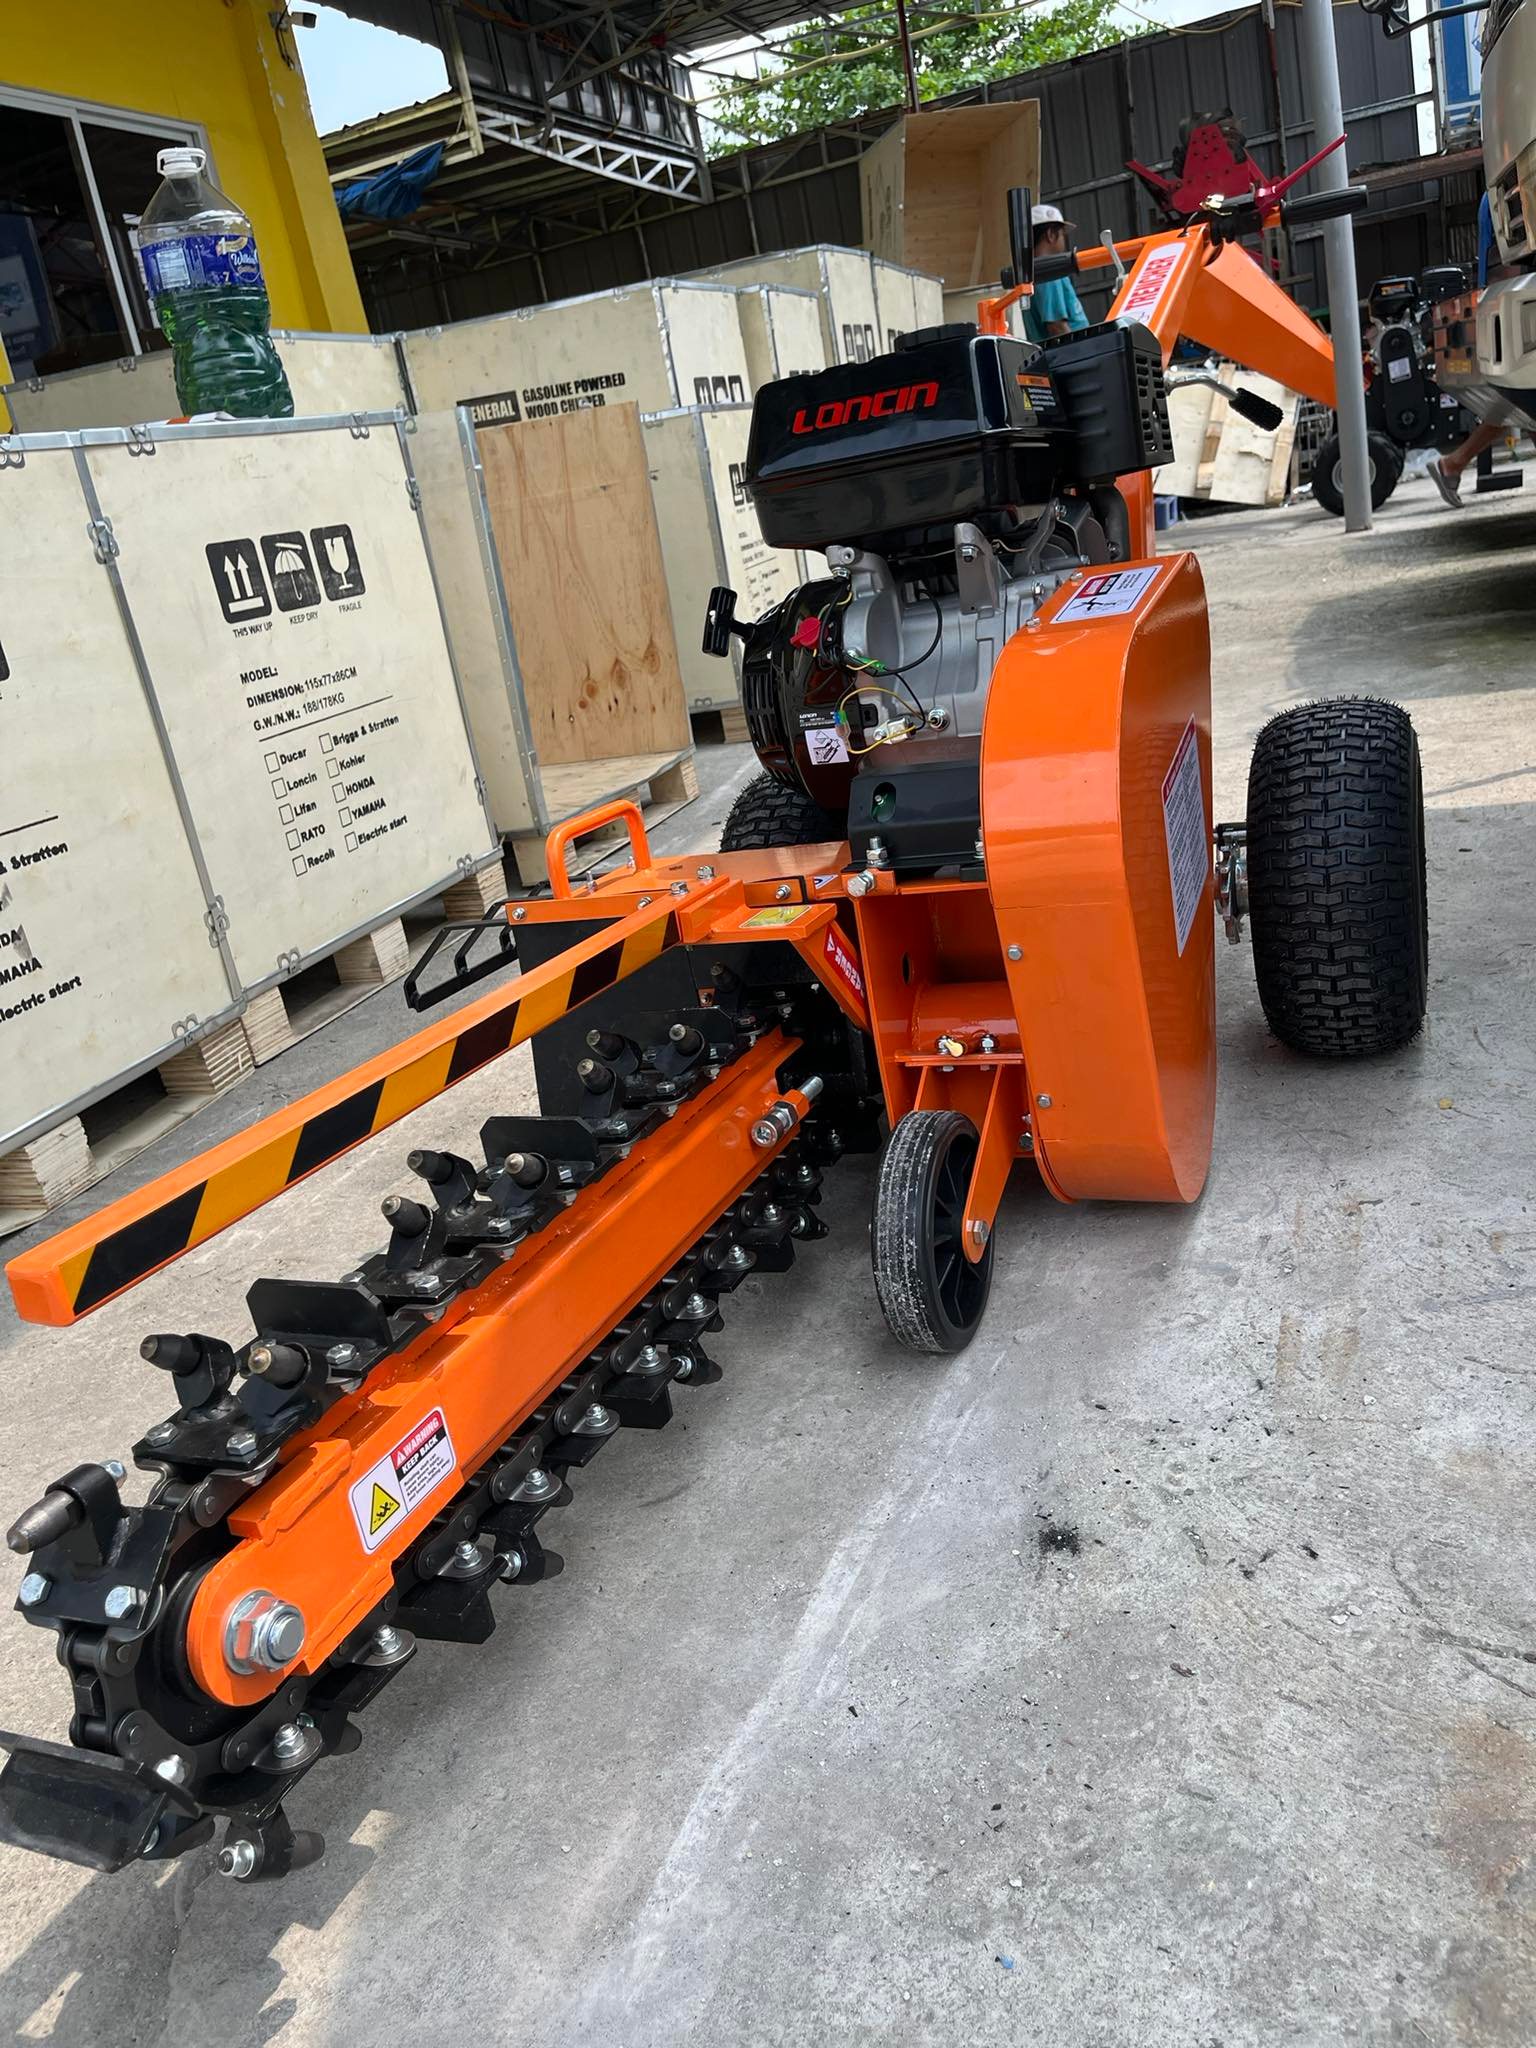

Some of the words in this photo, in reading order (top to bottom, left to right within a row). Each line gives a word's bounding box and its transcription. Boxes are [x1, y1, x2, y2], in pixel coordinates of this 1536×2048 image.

[522, 382, 573, 403] GASOLINE
[574, 372, 626, 394] POWERED
[470, 400, 516, 422] ENERAL
[525, 401, 559, 420] WOOD
[560, 393, 606, 413] CHIER
[289, 613, 305, 625] KEEP
[306, 611, 319, 621] DRY
[338, 601, 362, 613] FRAGILE
[233, 625, 249, 638] THIS
[249, 624, 264, 635] WAY
[264, 621, 273, 631] UP
[240, 666, 279, 685] MODEL:
[246, 684, 304, 708] DIMENSION:
[304, 666, 358, 691] 115x77x86CM
[253, 709, 300, 731] G.W./N.W.:
[302, 692, 346, 714] 188/178KG
[332, 731, 360, 747] Briggs
[361, 726, 368, 736] &
[369, 715, 400, 733] Stratton
[280, 749, 307, 765] Ducar
[339, 754, 366, 772] Kohler
[287, 772, 318, 791] Loncin
[345, 776, 376, 796] HONDA
[293, 801, 317, 817] Lifan
[351, 797, 387, 820] YAMAHA
[300, 824, 326, 843] RATO
[358, 824, 388, 845] Electric
[389, 815, 408, 830] start
[10, 842, 69, 870] Stratton
[0, 929, 22, 948] DA
[0, 993, 46, 1023] lectric
[48, 976, 82, 999] start
[402, 1417, 439, 1456] WARNING
[402, 1453, 420, 1474] KEEP
[419, 1434, 439, 1457] BACK
